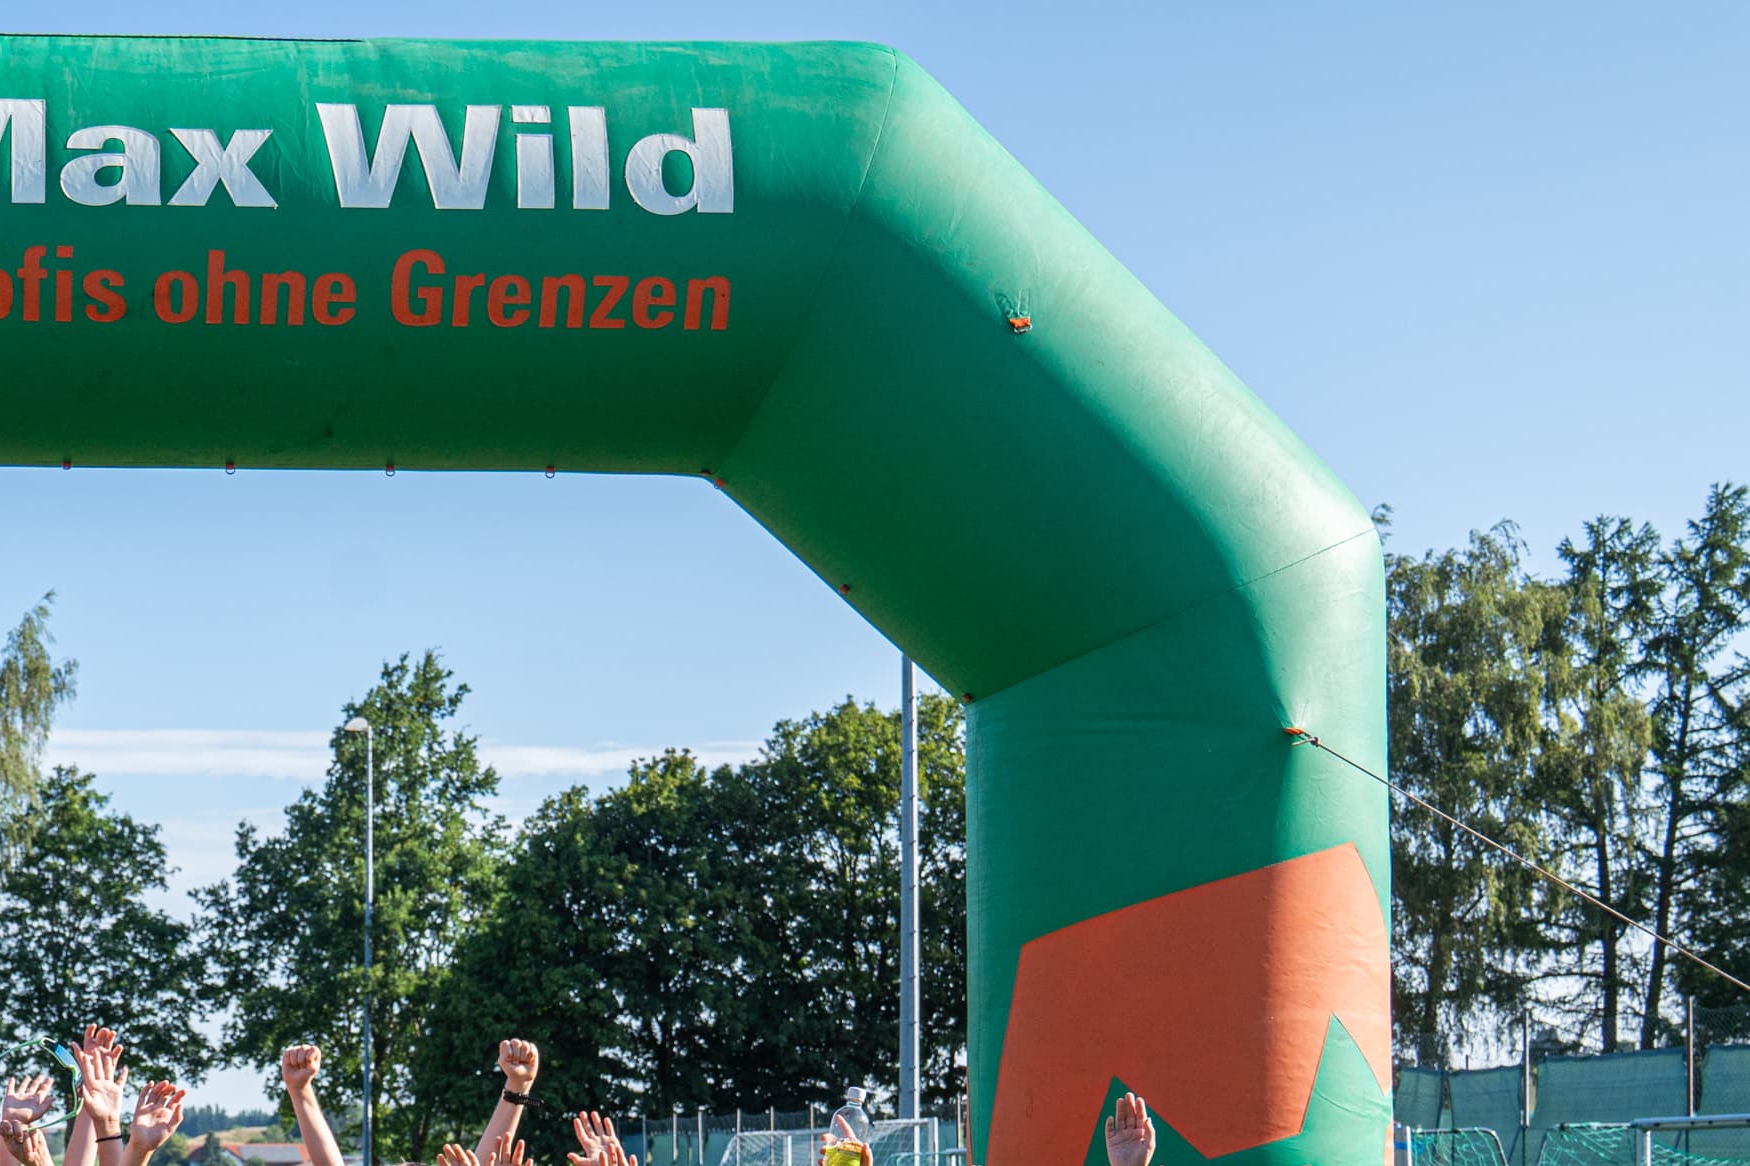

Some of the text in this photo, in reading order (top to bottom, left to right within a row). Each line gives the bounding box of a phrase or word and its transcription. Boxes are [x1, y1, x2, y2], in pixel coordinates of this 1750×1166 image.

[315, 103, 734, 215] Wild
[154, 249, 356, 326] ohne
[391, 248, 730, 330] Grenzen
